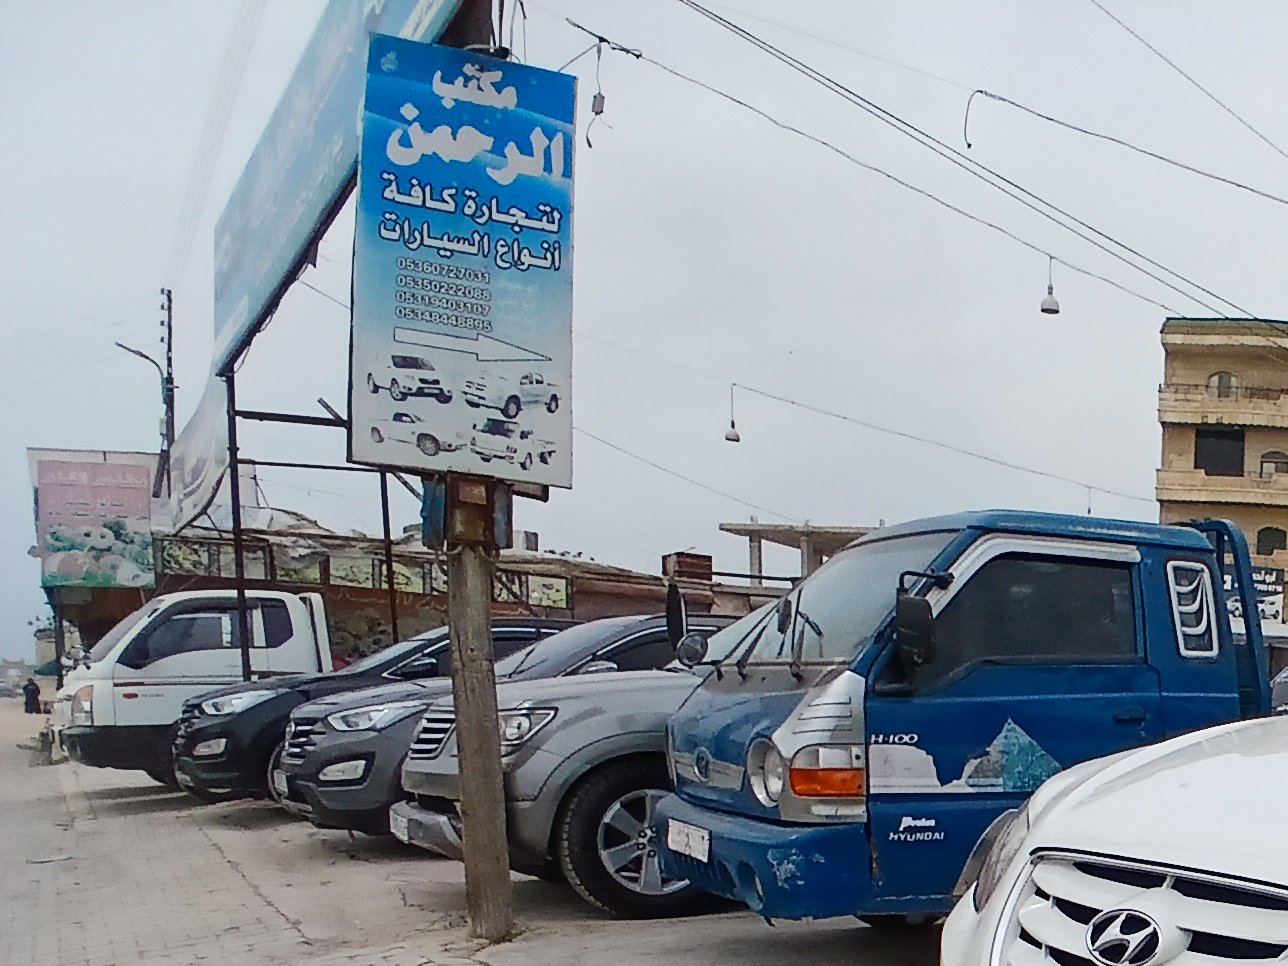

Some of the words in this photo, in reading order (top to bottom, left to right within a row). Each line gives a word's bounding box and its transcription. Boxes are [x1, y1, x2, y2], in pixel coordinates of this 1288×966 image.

[432, 63, 518, 110] مكتب
[386, 102, 564, 185] الرحمن
[380, 171, 458, 214] كافة
[462, 189, 563, 234] لتجارة
[379, 211, 490, 259] السيارات
[396, 256, 490, 284] 05360727031
[888, 832, 945, 841] HYUNDAI
